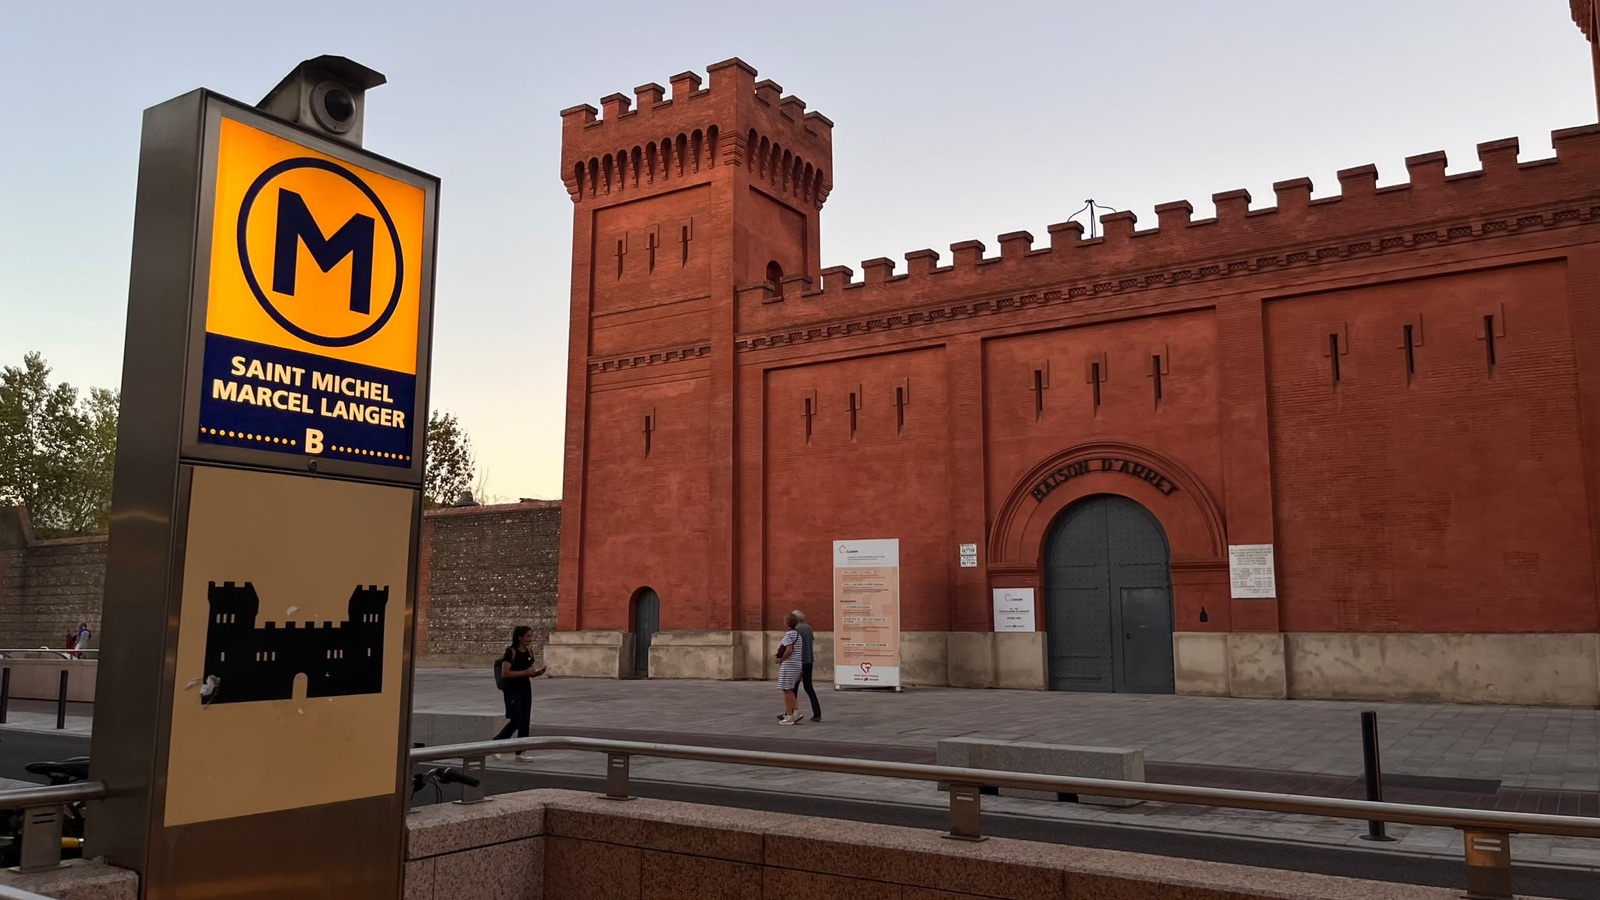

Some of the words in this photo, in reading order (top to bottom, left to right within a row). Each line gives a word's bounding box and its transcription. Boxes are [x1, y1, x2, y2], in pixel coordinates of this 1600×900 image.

[272, 187, 376, 315] M
[212, 378, 315, 415] MARCEL
[320, 397, 406, 429] LANGER
[230, 355, 306, 387] SAINT
[311, 371, 394, 404] MICHEL
[304, 427, 325, 455] B
[1030, 459, 1090, 503] MAISON
